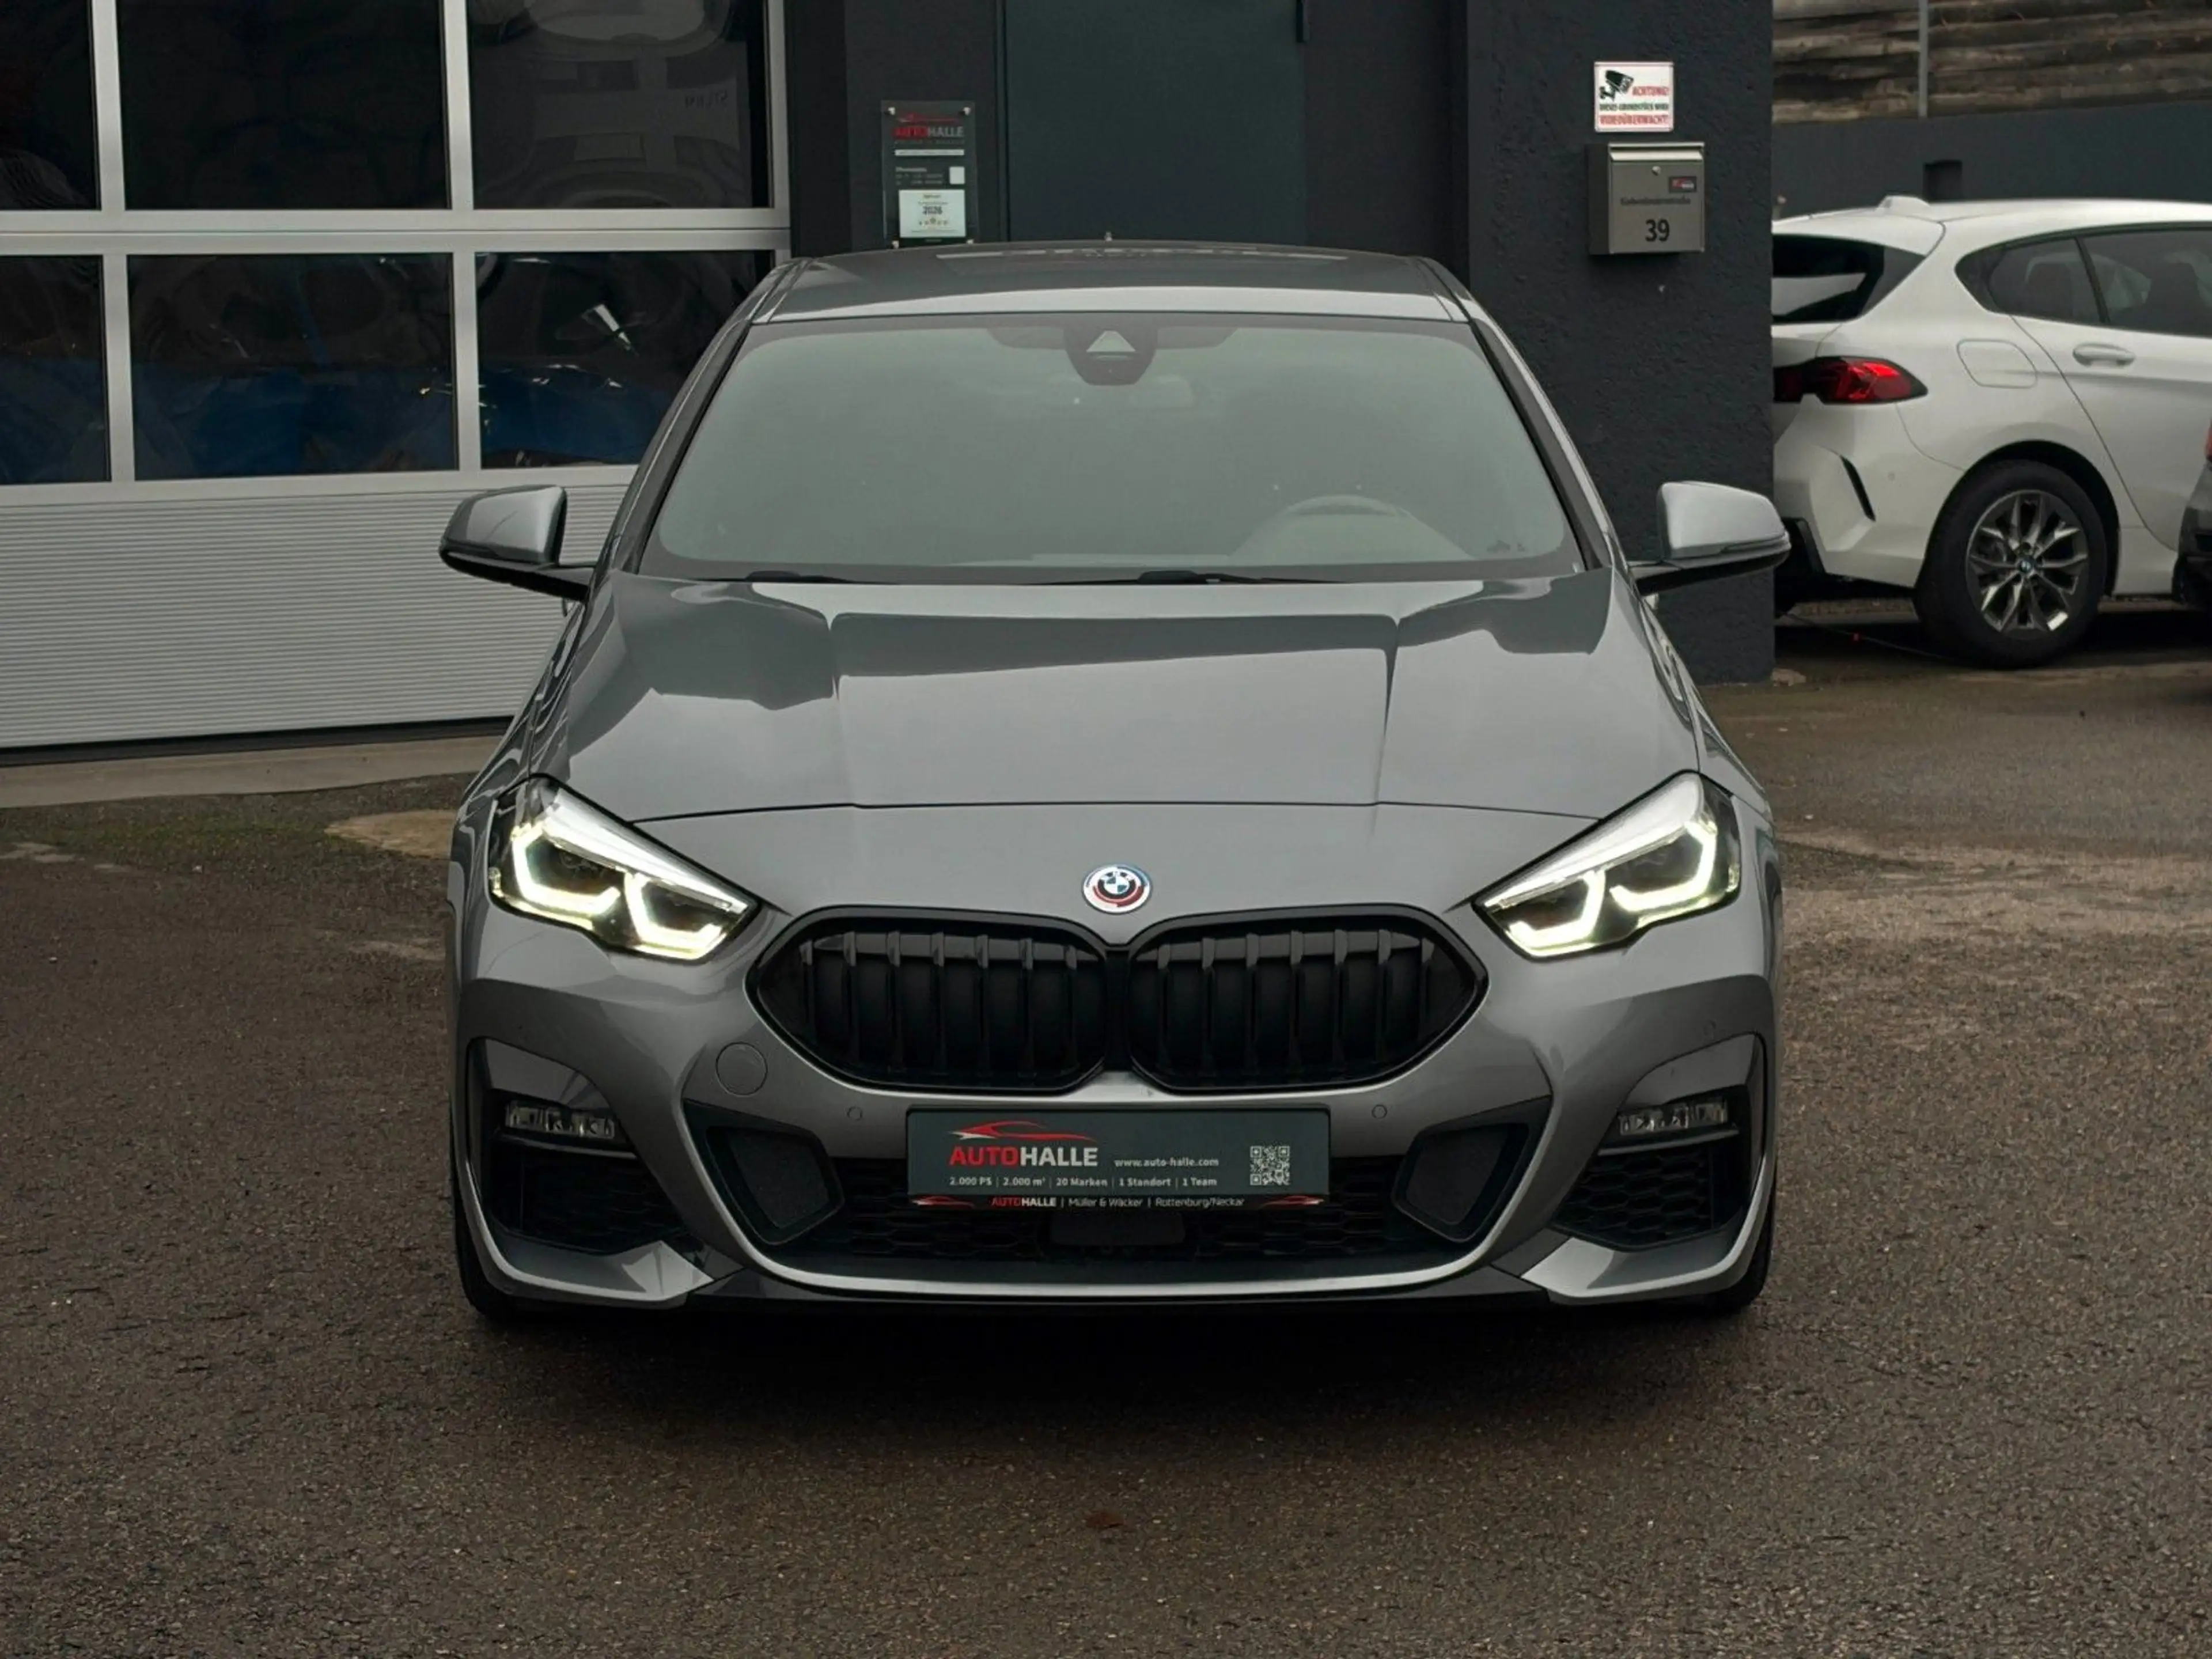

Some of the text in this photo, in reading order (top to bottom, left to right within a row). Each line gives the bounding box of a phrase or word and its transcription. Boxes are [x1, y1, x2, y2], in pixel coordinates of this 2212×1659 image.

[1645, 219, 1670, 242] 39
[950, 1146, 1099, 1166] AUTOHALLE
[1114, 1157, 1219, 1167] www.auto-halle.com
[950, 1177, 977, 1186] 2.000
[979, 1177, 992, 1186] PS
[1003, 1177, 1031, 1186] 2.000
[1056, 1177, 1067, 1186] 20
[1070, 1177, 1108, 1187] Marken
[1119, 1178, 1125, 1187] 1
[1127, 1177, 1171, 1187] Standort
[1182, 1178, 1188, 1187] 1
[1190, 1177, 1218, 1187] Team
[991, 1197, 1056, 1207] AUTOHALLE
